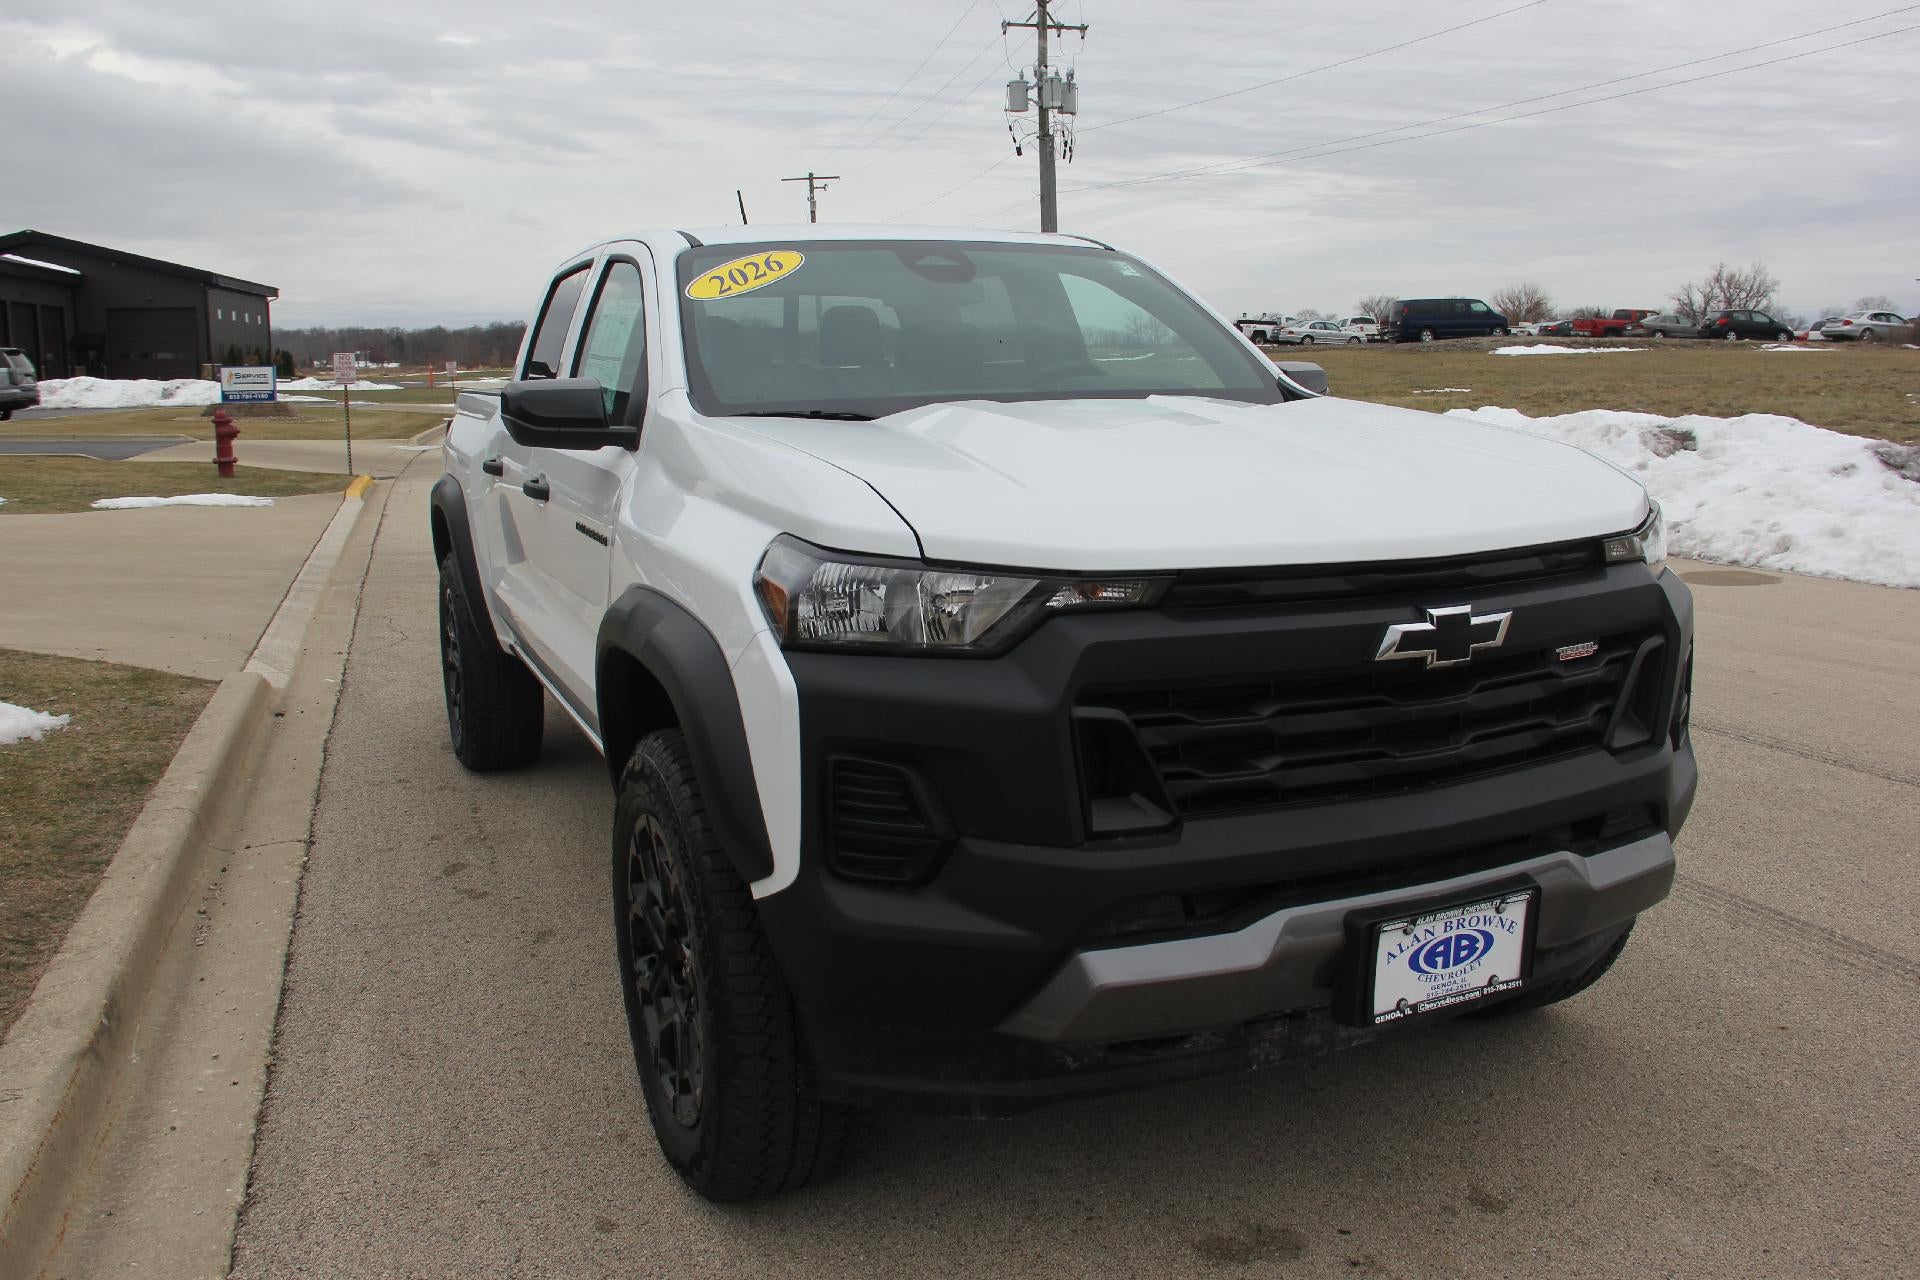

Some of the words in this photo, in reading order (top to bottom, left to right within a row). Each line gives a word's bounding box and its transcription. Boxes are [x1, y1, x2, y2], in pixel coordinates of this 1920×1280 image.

[709, 254, 784, 295] 2026
[1416, 914, 1435, 926] ALAN
[1463, 899, 1500, 915] CHEVROLET
[1387, 926, 1435, 965] ALAN
[1443, 914, 1518, 934] BROWNE
[1423, 934, 1480, 970] AB
[1417, 960, 1482, 983] CHEVROLET
[1460, 976, 1468, 984] IL
[1375, 1010, 1404, 1024] GENOA,
[1404, 1007, 1413, 1015] IL
[1483, 979, 1522, 995] 815-784-2511
